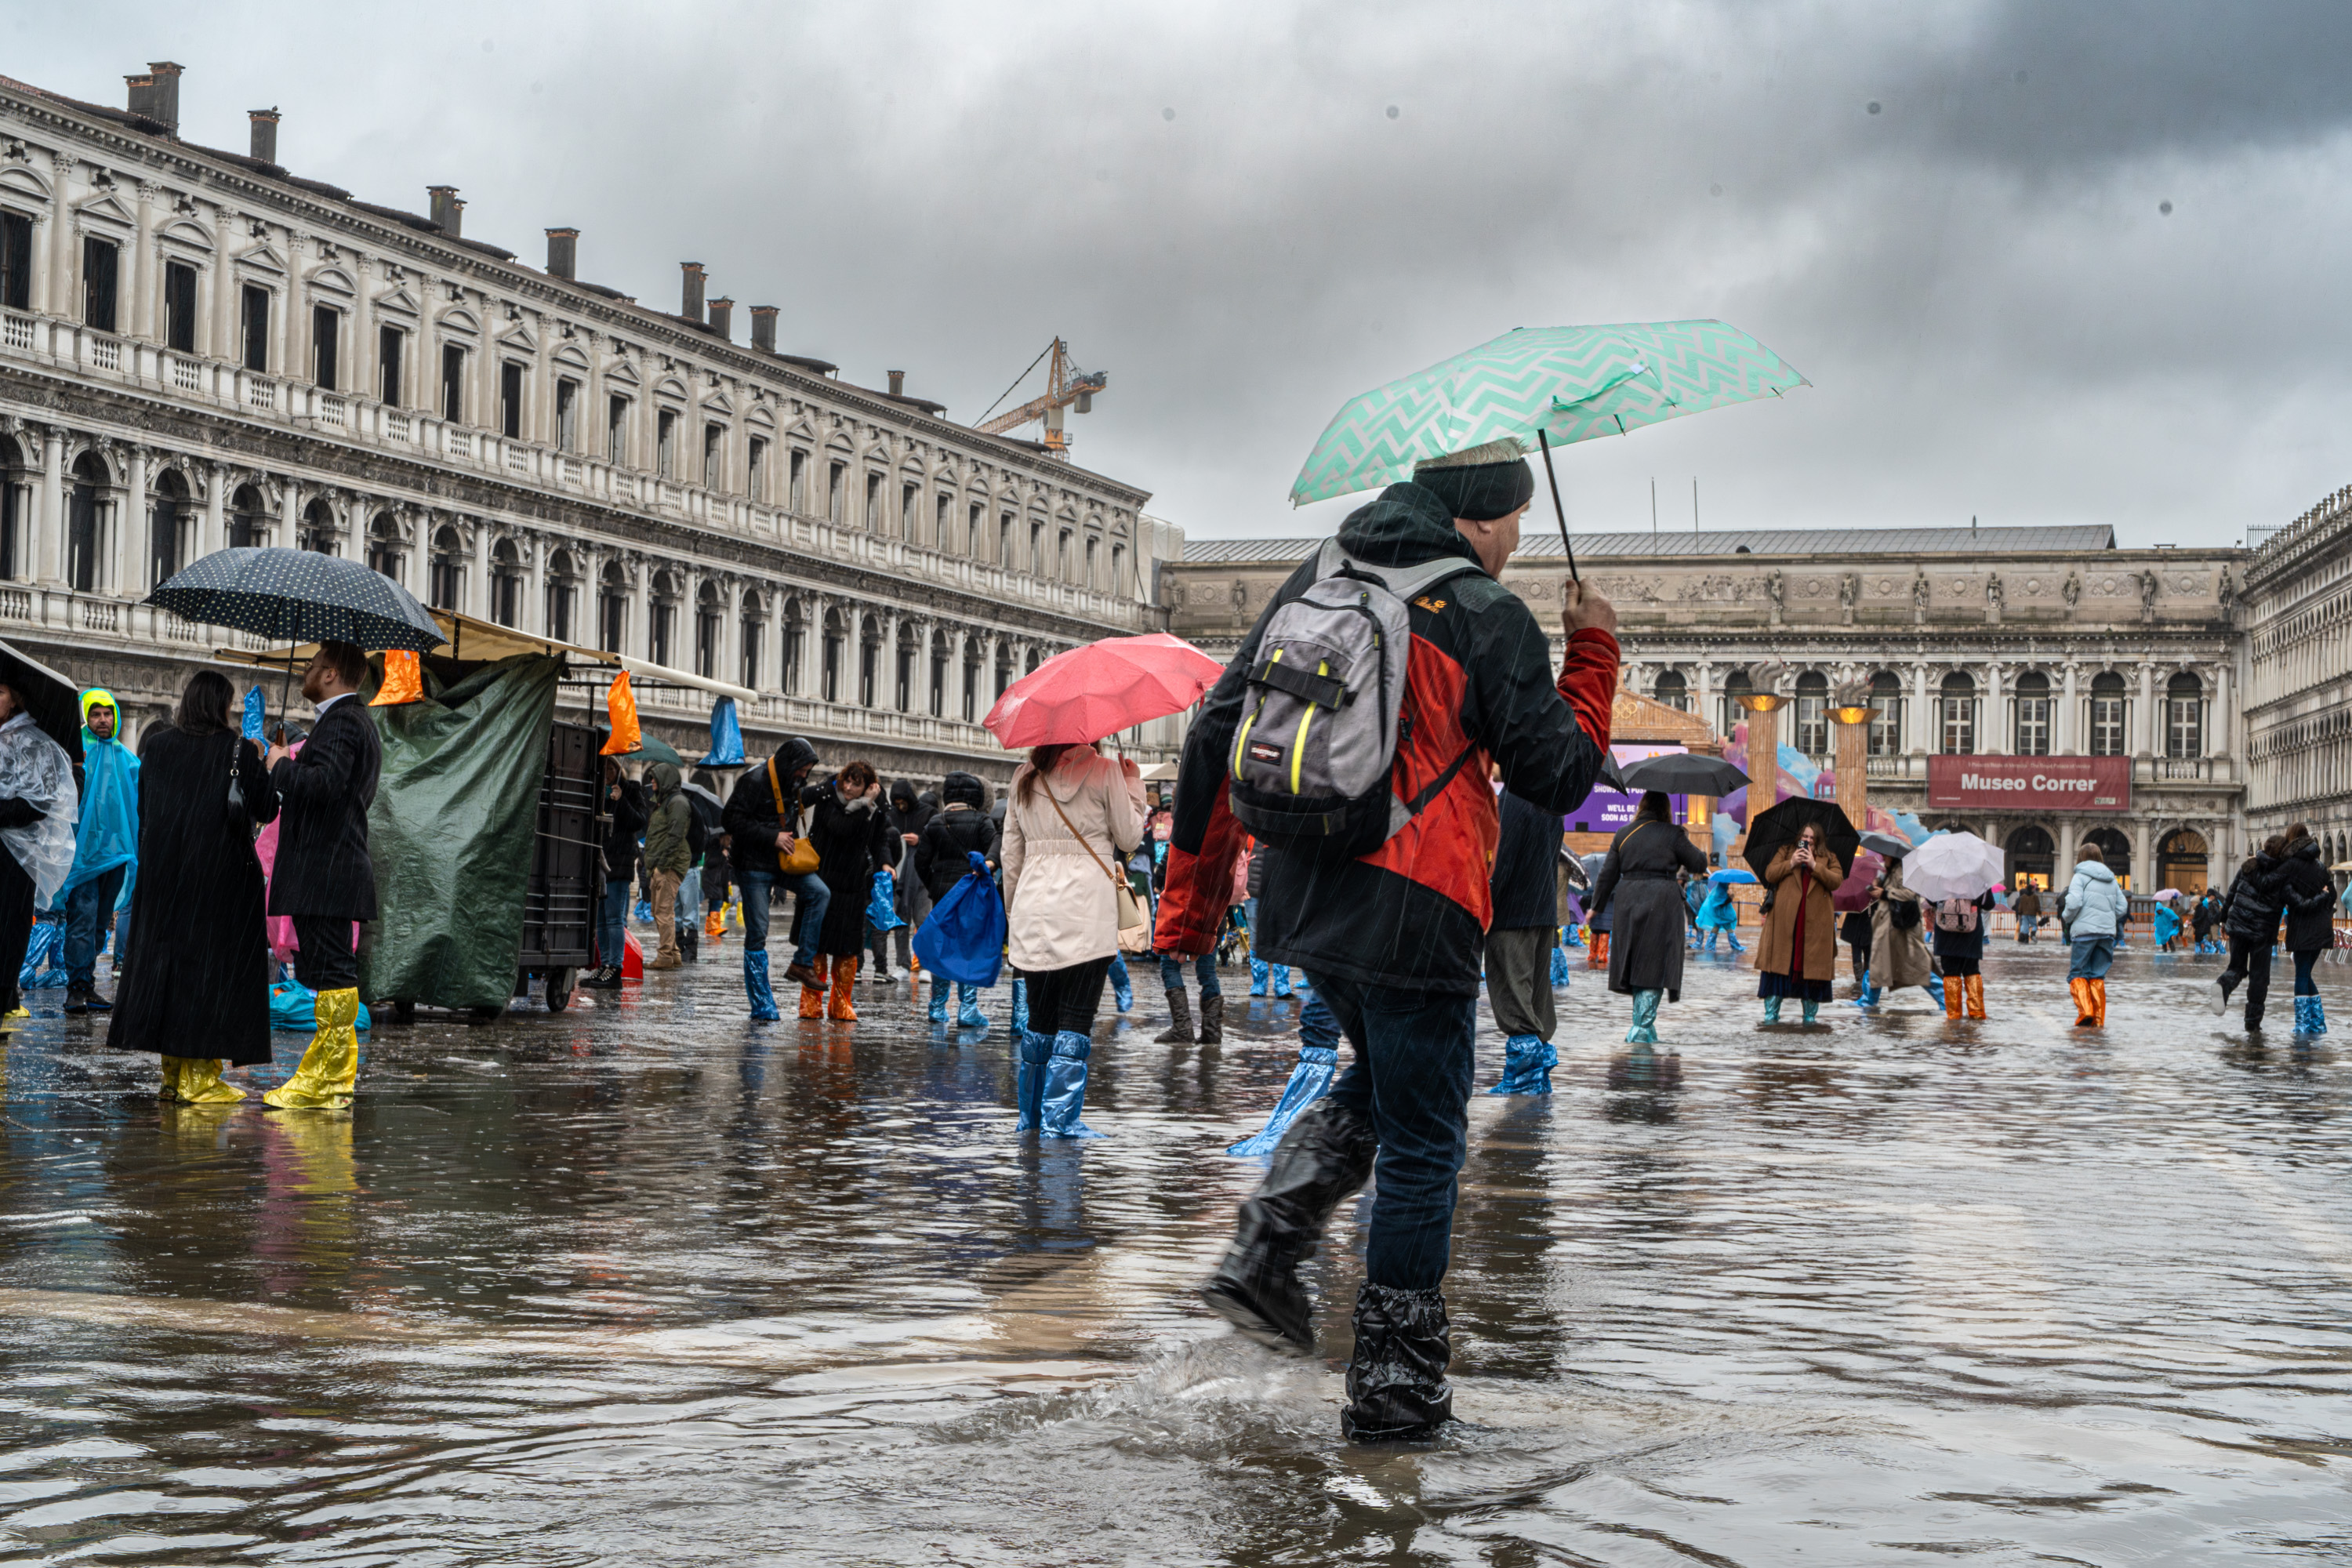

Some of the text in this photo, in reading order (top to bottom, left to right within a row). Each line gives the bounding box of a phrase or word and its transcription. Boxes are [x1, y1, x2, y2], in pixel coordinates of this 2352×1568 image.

[1962, 774, 2097, 792] Museo Correr
[1601, 813, 1619, 822] SOON
